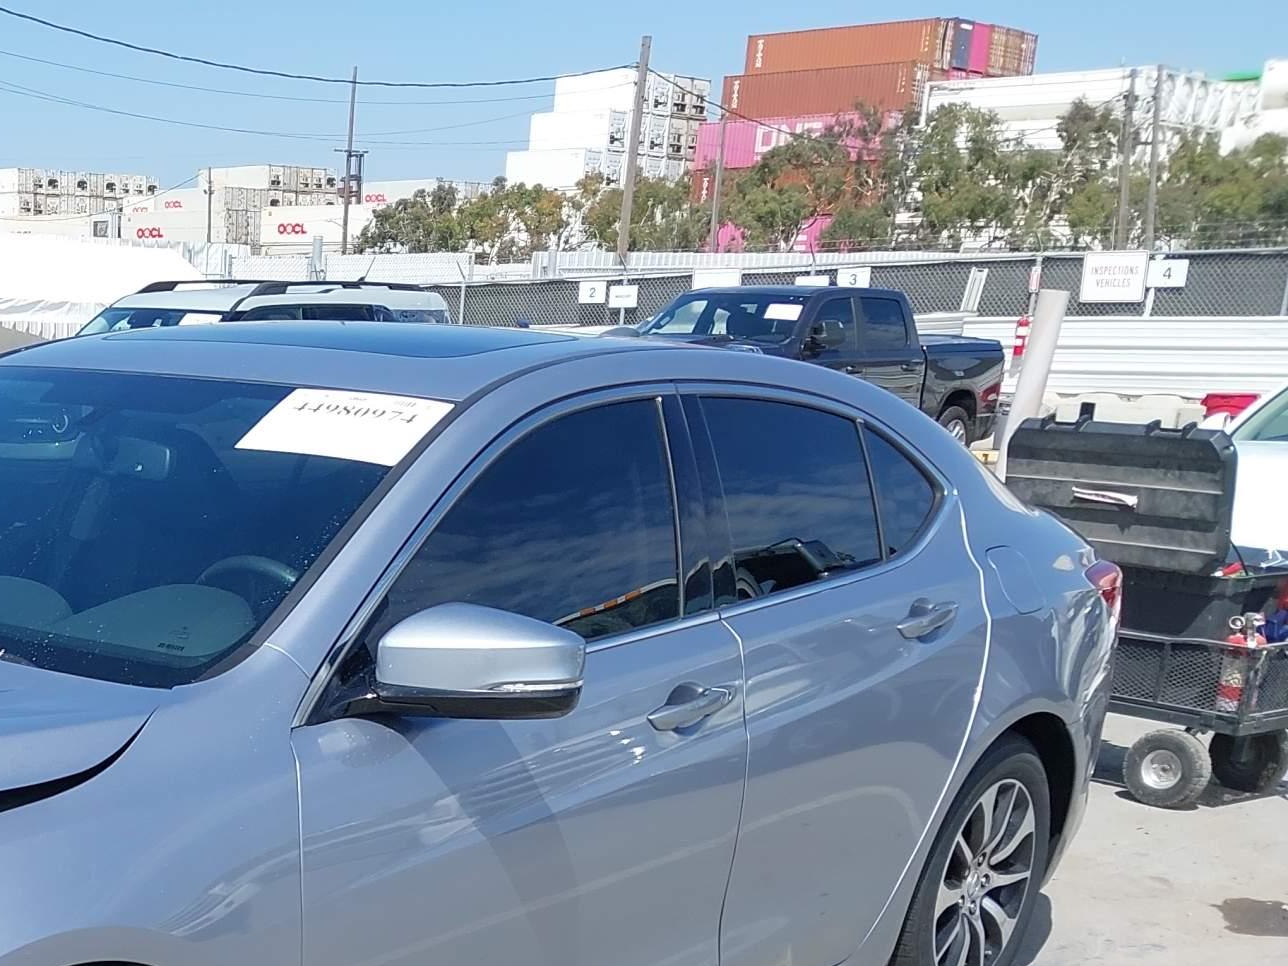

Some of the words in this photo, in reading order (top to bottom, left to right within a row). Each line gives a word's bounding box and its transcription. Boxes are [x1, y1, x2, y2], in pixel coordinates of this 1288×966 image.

[364, 193, 387, 203] OOCL
[136, 227, 164, 239] OOCL
[277, 223, 307, 235] OOCL
[1090, 265, 1140, 276] INSPECTIONS
[1162, 267, 1172, 280] 4
[848, 274, 857, 286] 3
[1095, 278, 1132, 288] VEHICLES
[589, 287, 597, 298] 2
